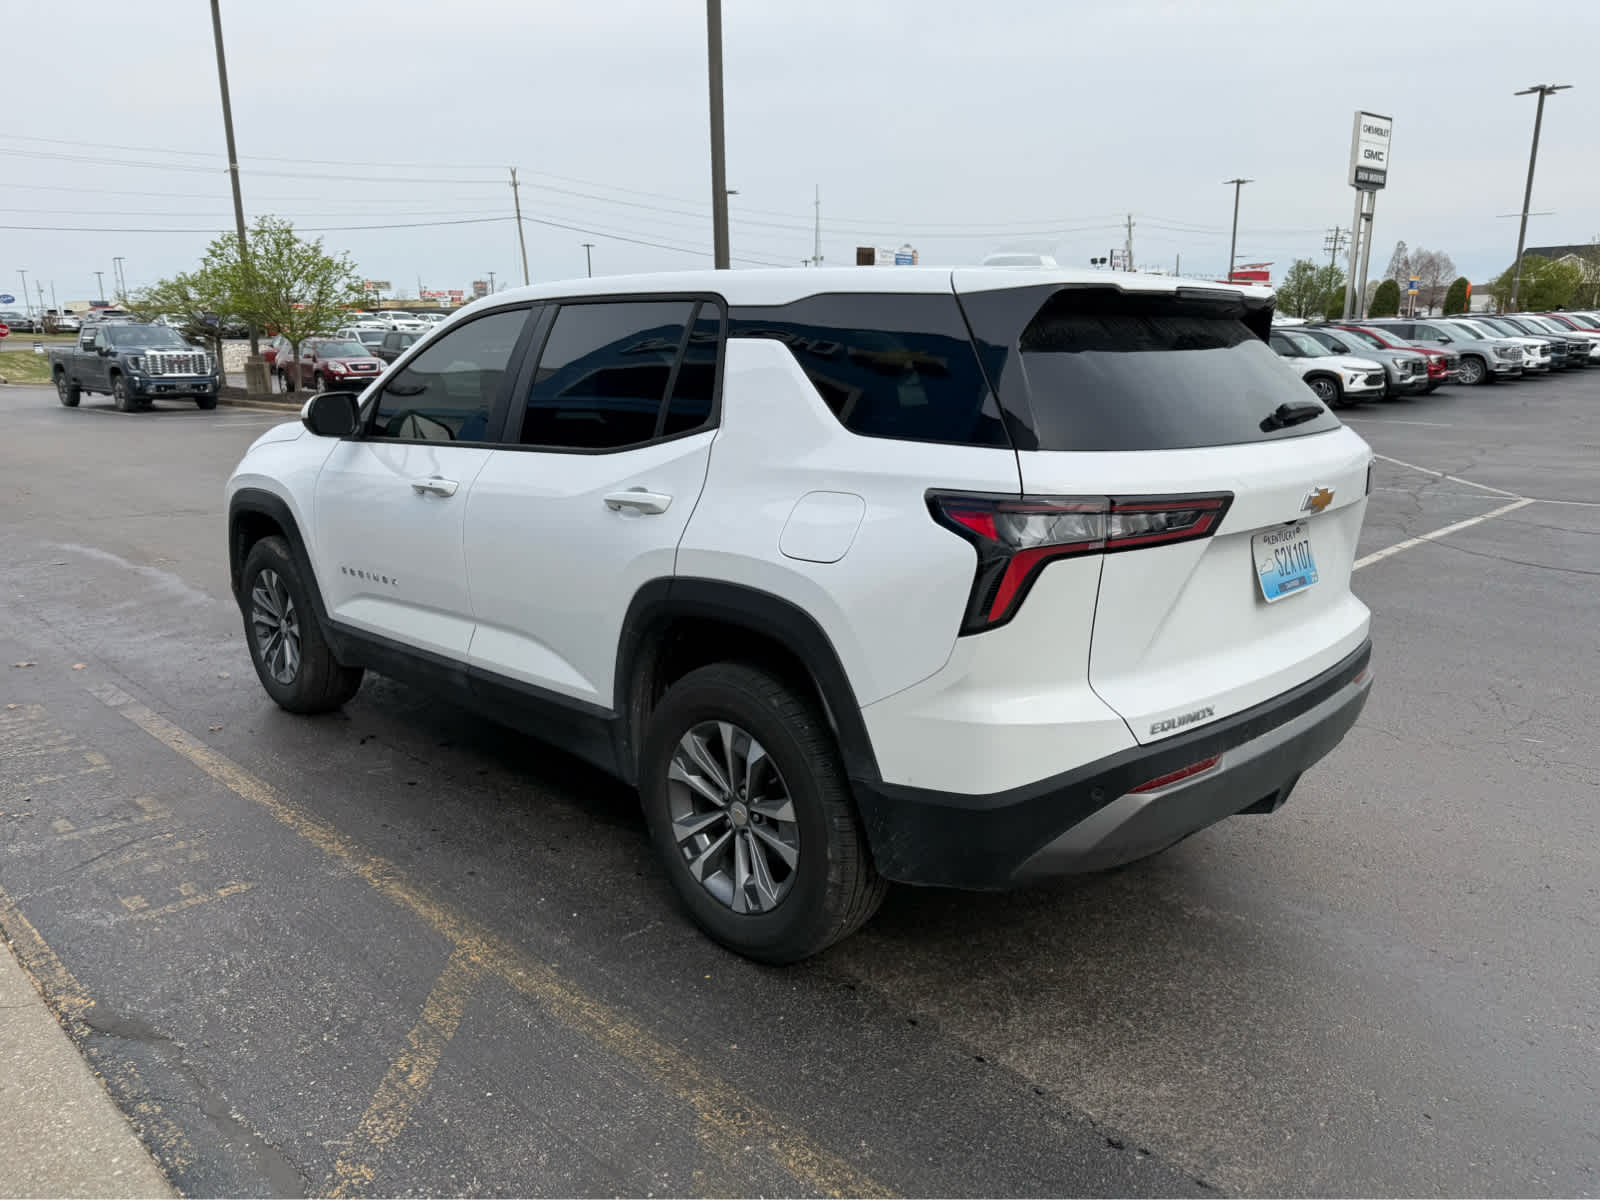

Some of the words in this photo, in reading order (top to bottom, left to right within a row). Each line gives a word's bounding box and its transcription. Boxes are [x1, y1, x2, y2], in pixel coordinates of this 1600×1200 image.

[1363, 125, 1389, 137] CHEVROLET
[1364, 149, 1384, 161] GMC
[1266, 530, 1296, 545] KENTUCKY
[1274, 540, 1312, 577] S2X107
[1150, 704, 1216, 735] EQUINOX
